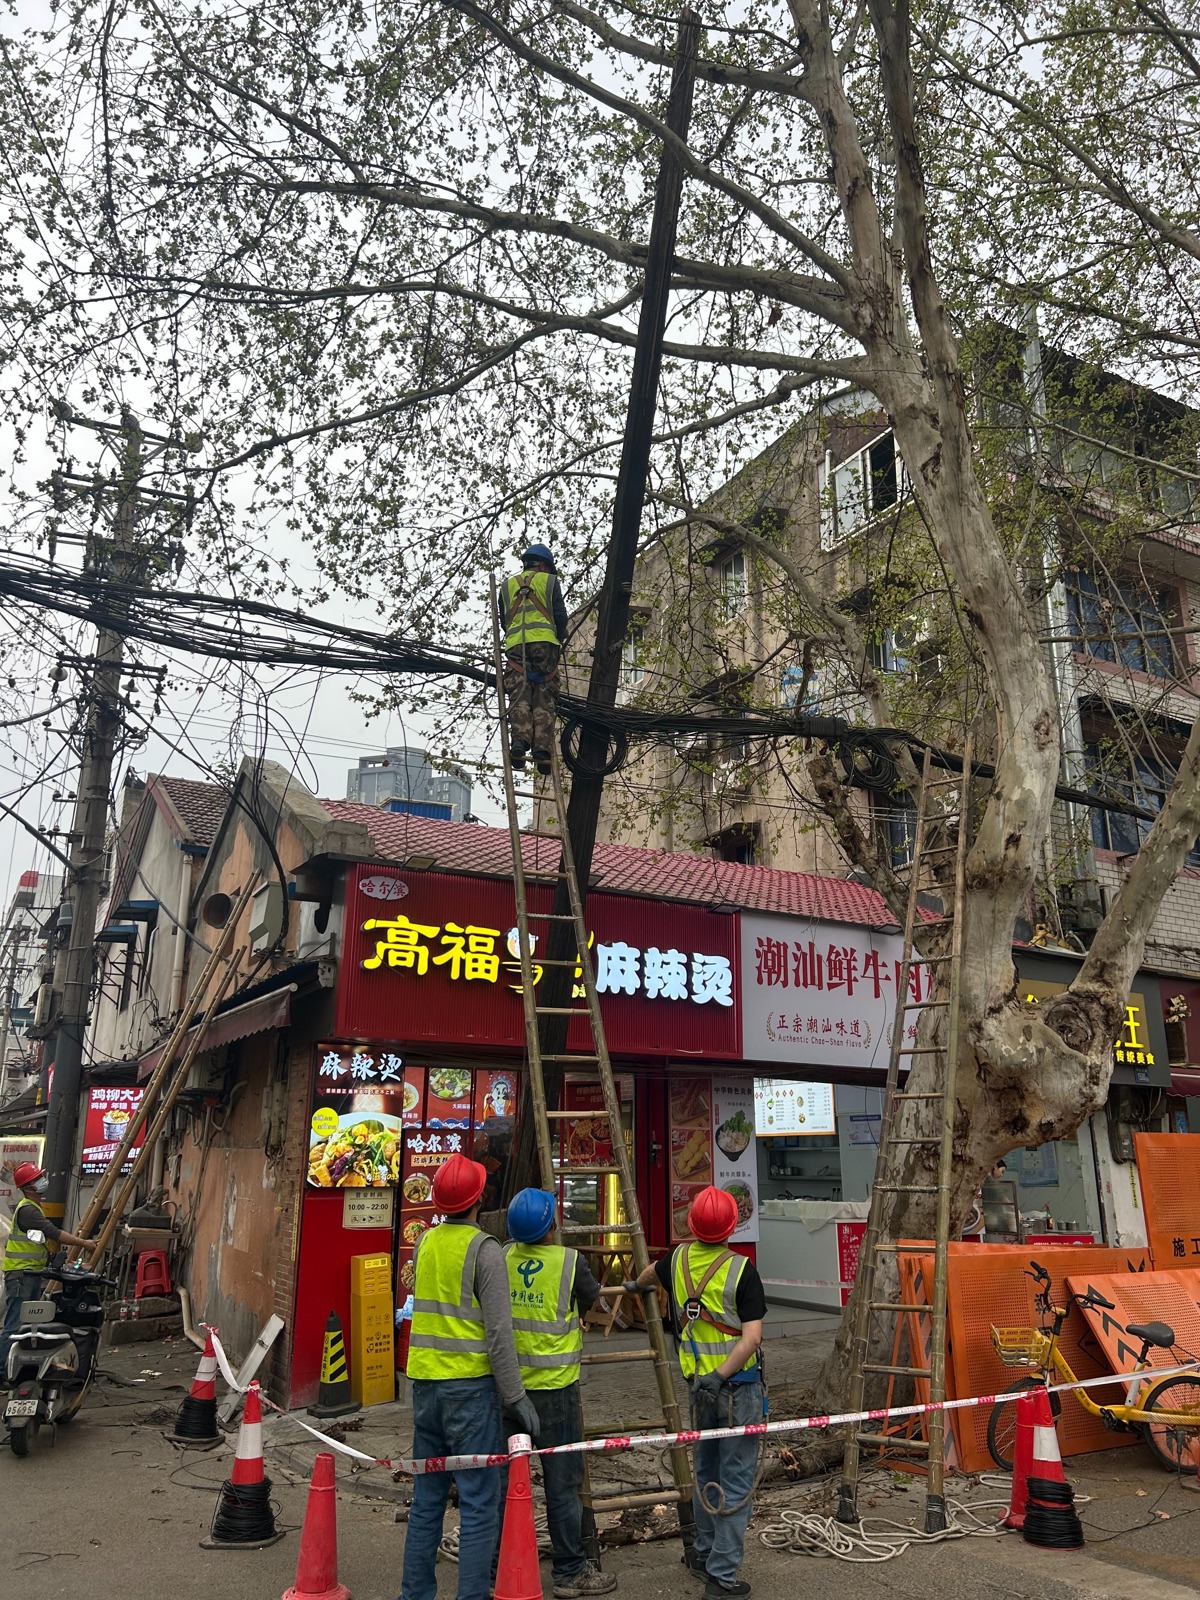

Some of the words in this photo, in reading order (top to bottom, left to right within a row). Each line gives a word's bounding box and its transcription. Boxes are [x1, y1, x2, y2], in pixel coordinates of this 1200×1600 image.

[361, 880, 406, 896] 哈尔滨
[361, 915, 501, 984] 高福
[596, 941, 734, 1007] 麻辣烫
[755, 936, 932, 1003] 潮汕鲜牛肉
[777, 1012, 862, 1038] 正宗潮汕味道
[777, 1034, 809, 1044] Authentic
[319, 1051, 402, 1081] 麻辣烫
[1115, 1050, 1155, 1065] 传统美食
[407, 1133, 462, 1153] 哈尔滨
[511, 1289, 544, 1303] 中国电信
